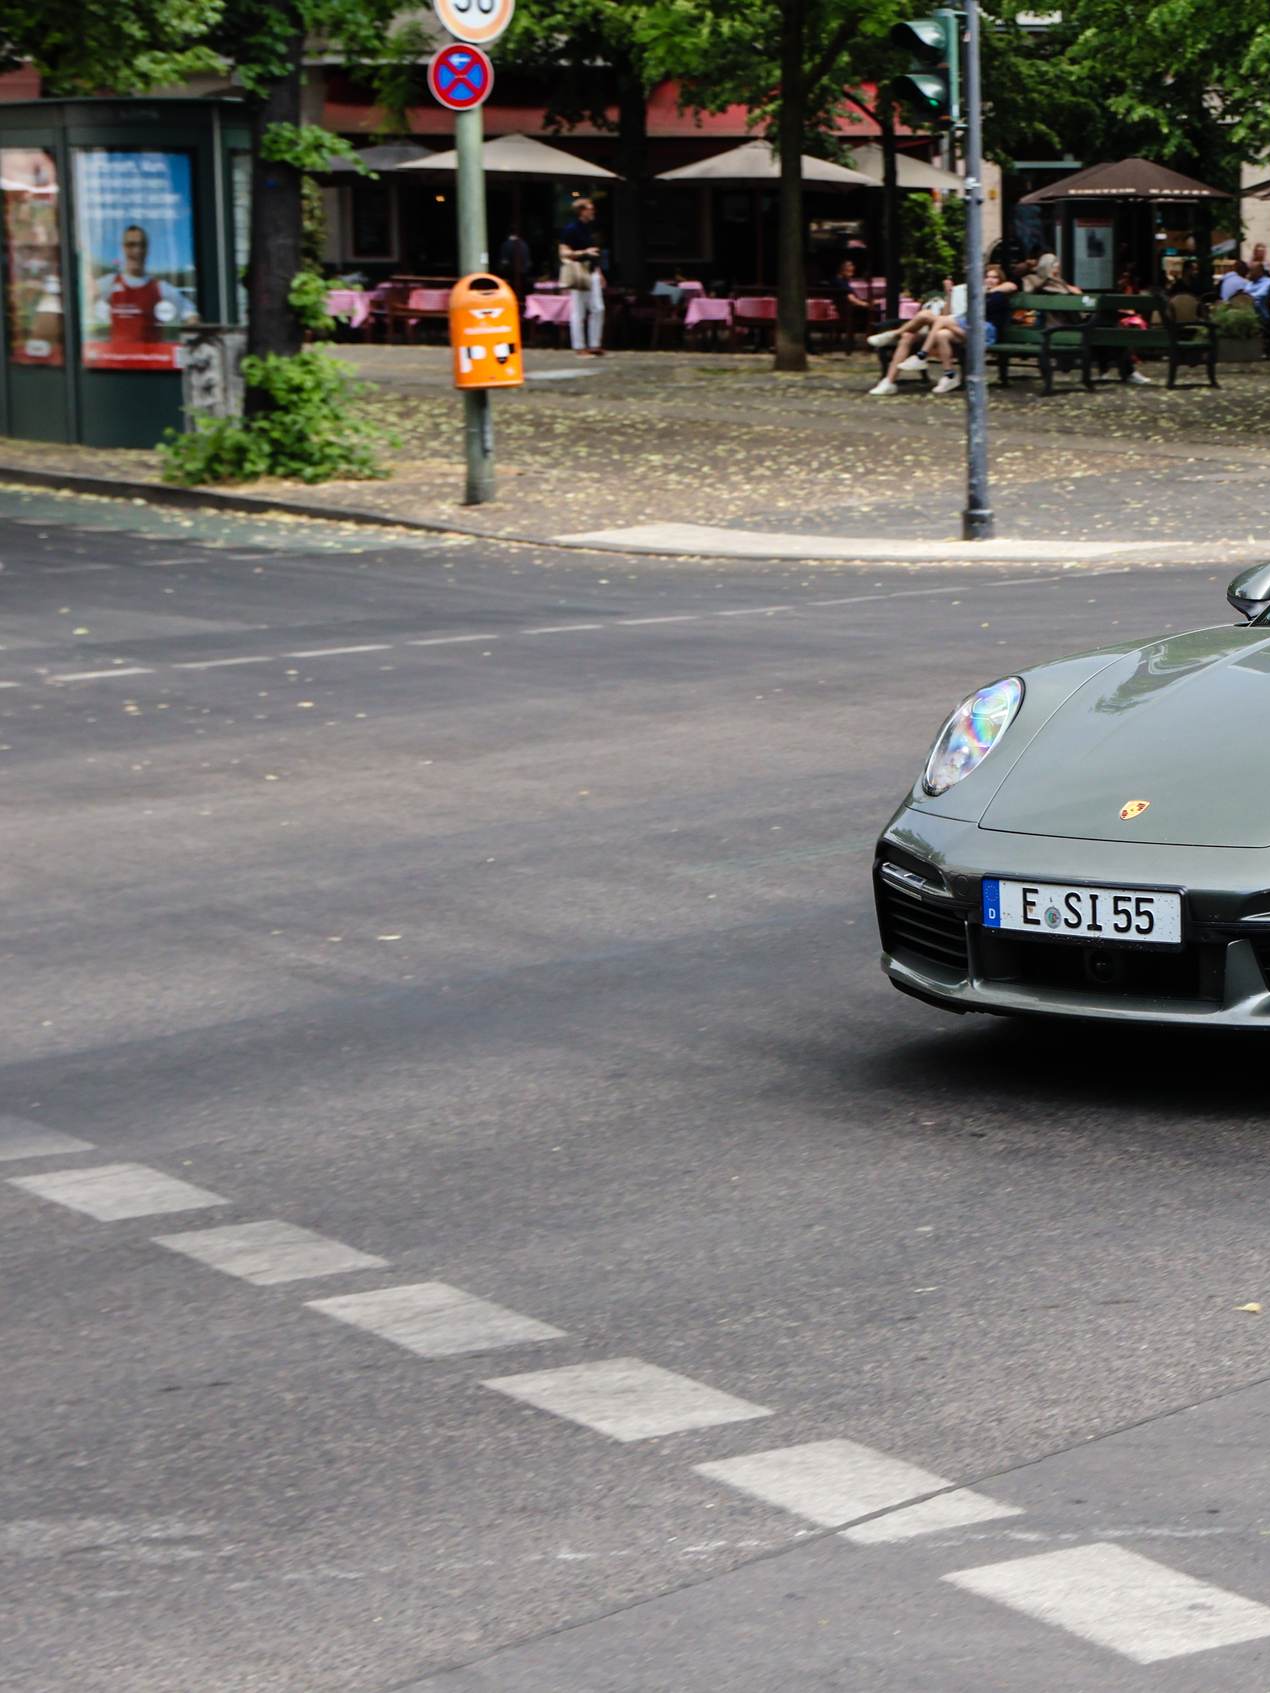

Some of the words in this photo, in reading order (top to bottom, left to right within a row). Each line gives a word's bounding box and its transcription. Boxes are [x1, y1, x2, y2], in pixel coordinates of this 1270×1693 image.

[988, 908, 996, 919] D
[1022, 887, 1041, 926] E
[1063, 892, 1102, 932] SI
[1113, 895, 1155, 935] 55
